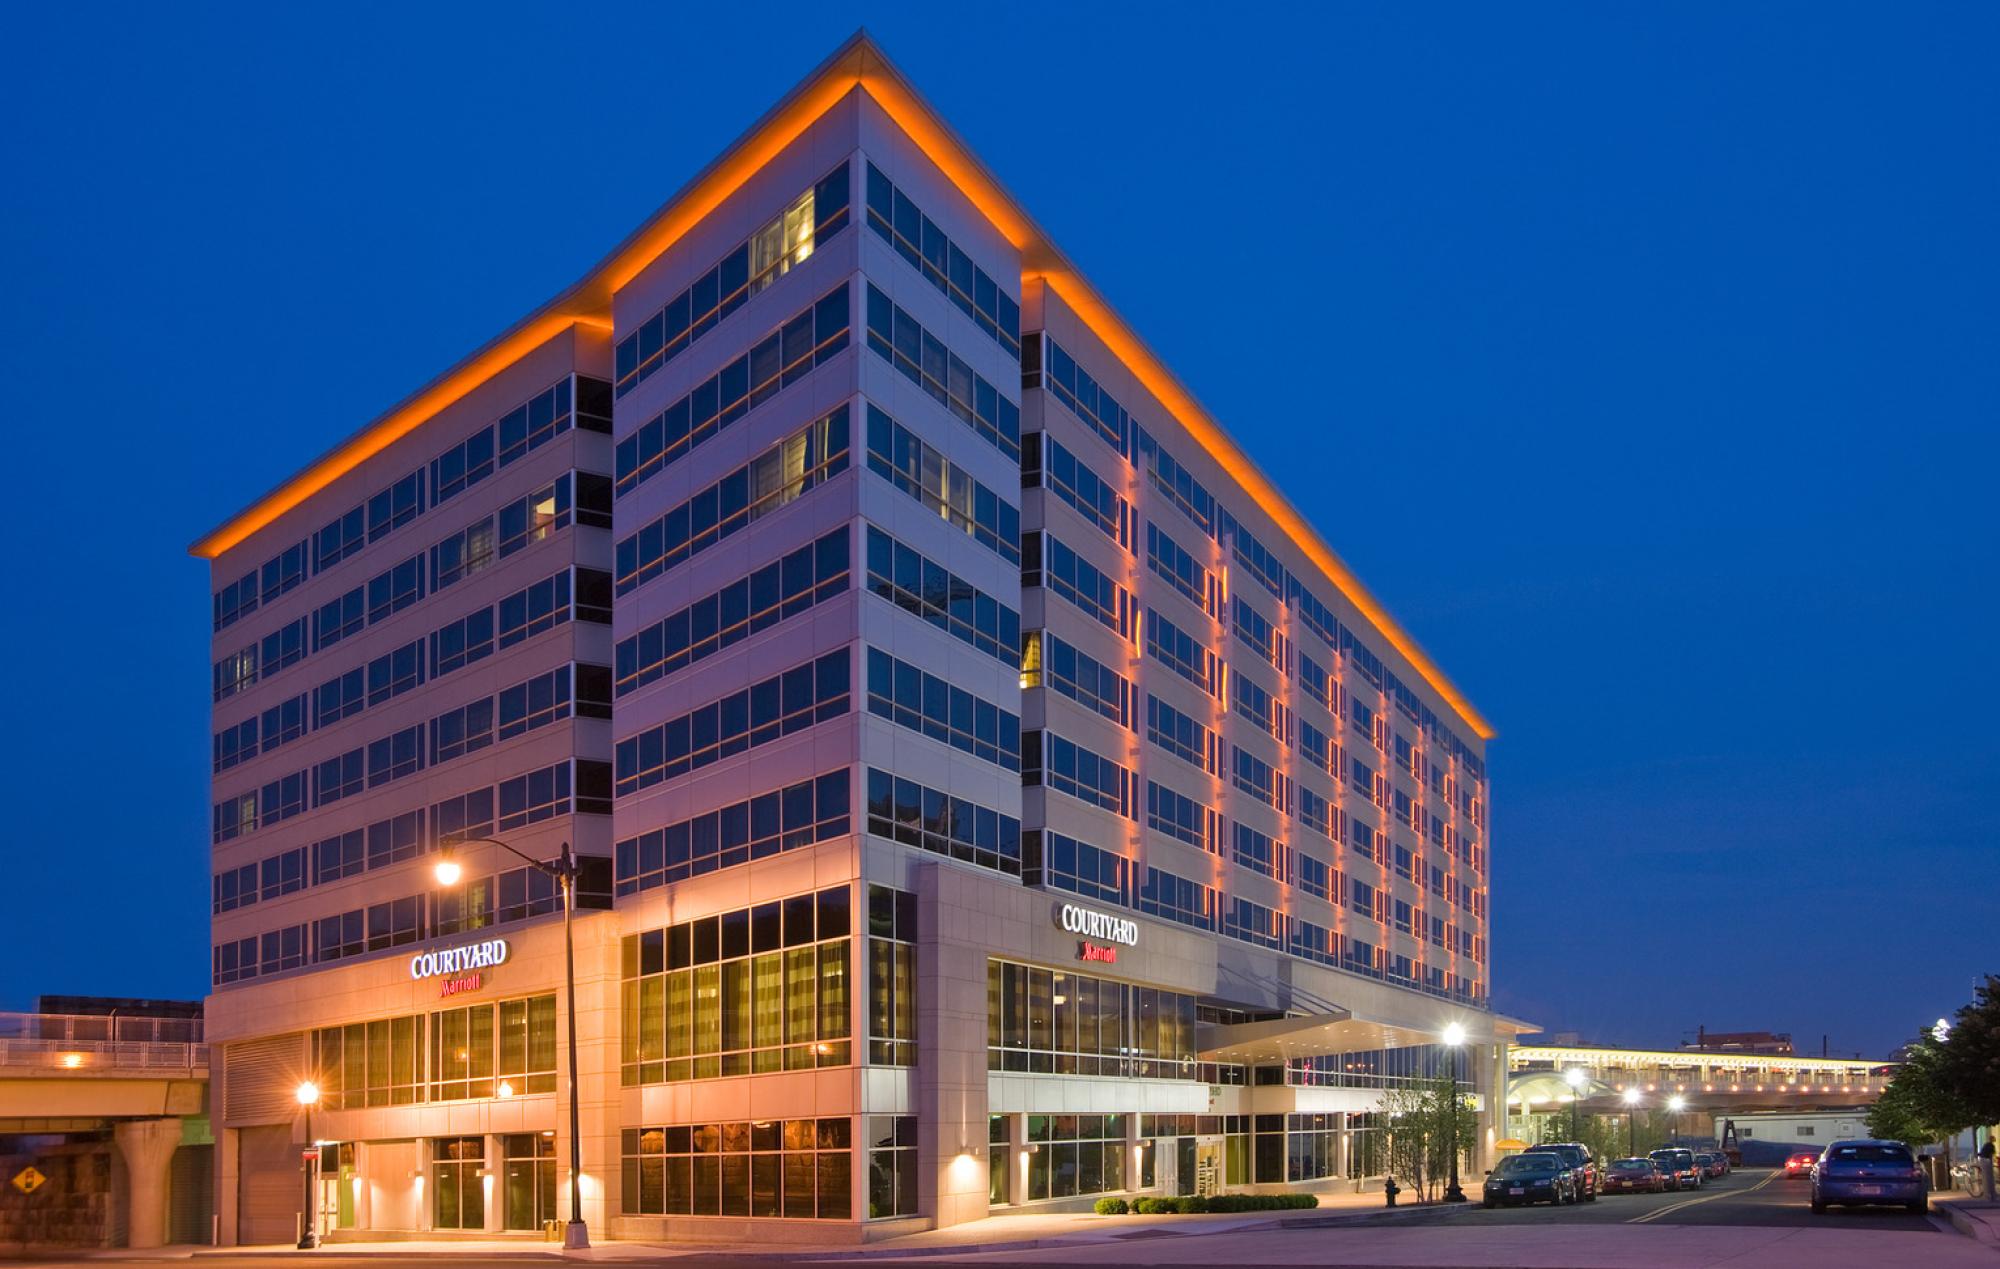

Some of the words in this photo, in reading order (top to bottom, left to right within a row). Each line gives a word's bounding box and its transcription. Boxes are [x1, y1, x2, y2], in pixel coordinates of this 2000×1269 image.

[1062, 904, 1138, 946] COURTYARD
[411, 939, 507, 979] COURTYARD
[1082, 941, 1117, 963] Marriott
[440, 973, 481, 997] Marriott
